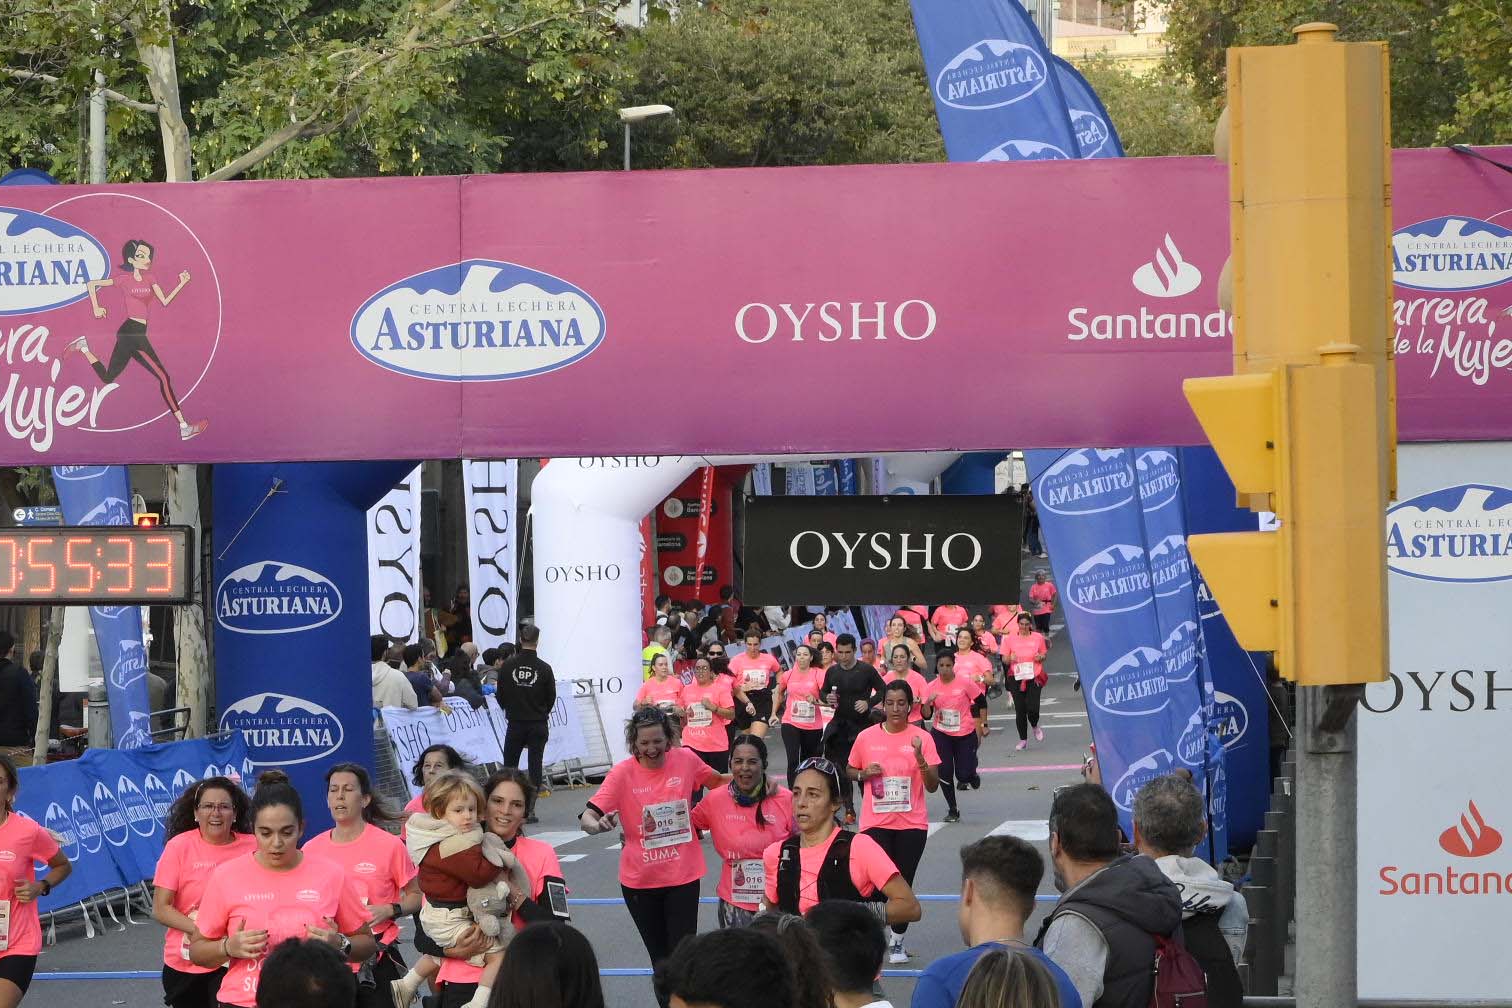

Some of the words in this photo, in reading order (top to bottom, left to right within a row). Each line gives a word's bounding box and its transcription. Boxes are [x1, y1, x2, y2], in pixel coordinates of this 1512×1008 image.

[13, 242, 85, 255] LECHERA
[1407, 242, 1458, 250] CENTRAL
[410, 301, 489, 316] CENTRAL
[496, 300, 578, 314] LECHERA
[1393, 295, 1488, 326] arrera
[371, 307, 587, 352] ASTURIANA
[735, 299, 938, 344] OYSHO
[1416, 327, 1434, 354] la
[1430, 319, 1512, 386] Muje
[1414, 518, 1481, 529] CENTRAL
[474, 461, 510, 636] OYSH
[790, 530, 982, 571] OYSHO
[545, 563, 621, 584] OYSHO
[233, 585, 275, 594] CENTRAL
[279, 585, 328, 594] LECHERA
[220, 590, 333, 618] ASTURIANA
[518, 670, 532, 679] BP
[575, 676, 623, 695] SHO
[234, 717, 276, 726] CENTRAL
[280, 717, 329, 726] LECHERA
[657, 819, 674, 828] 016
[642, 848, 680, 864] SUMA
[745, 876, 763, 884] 016
